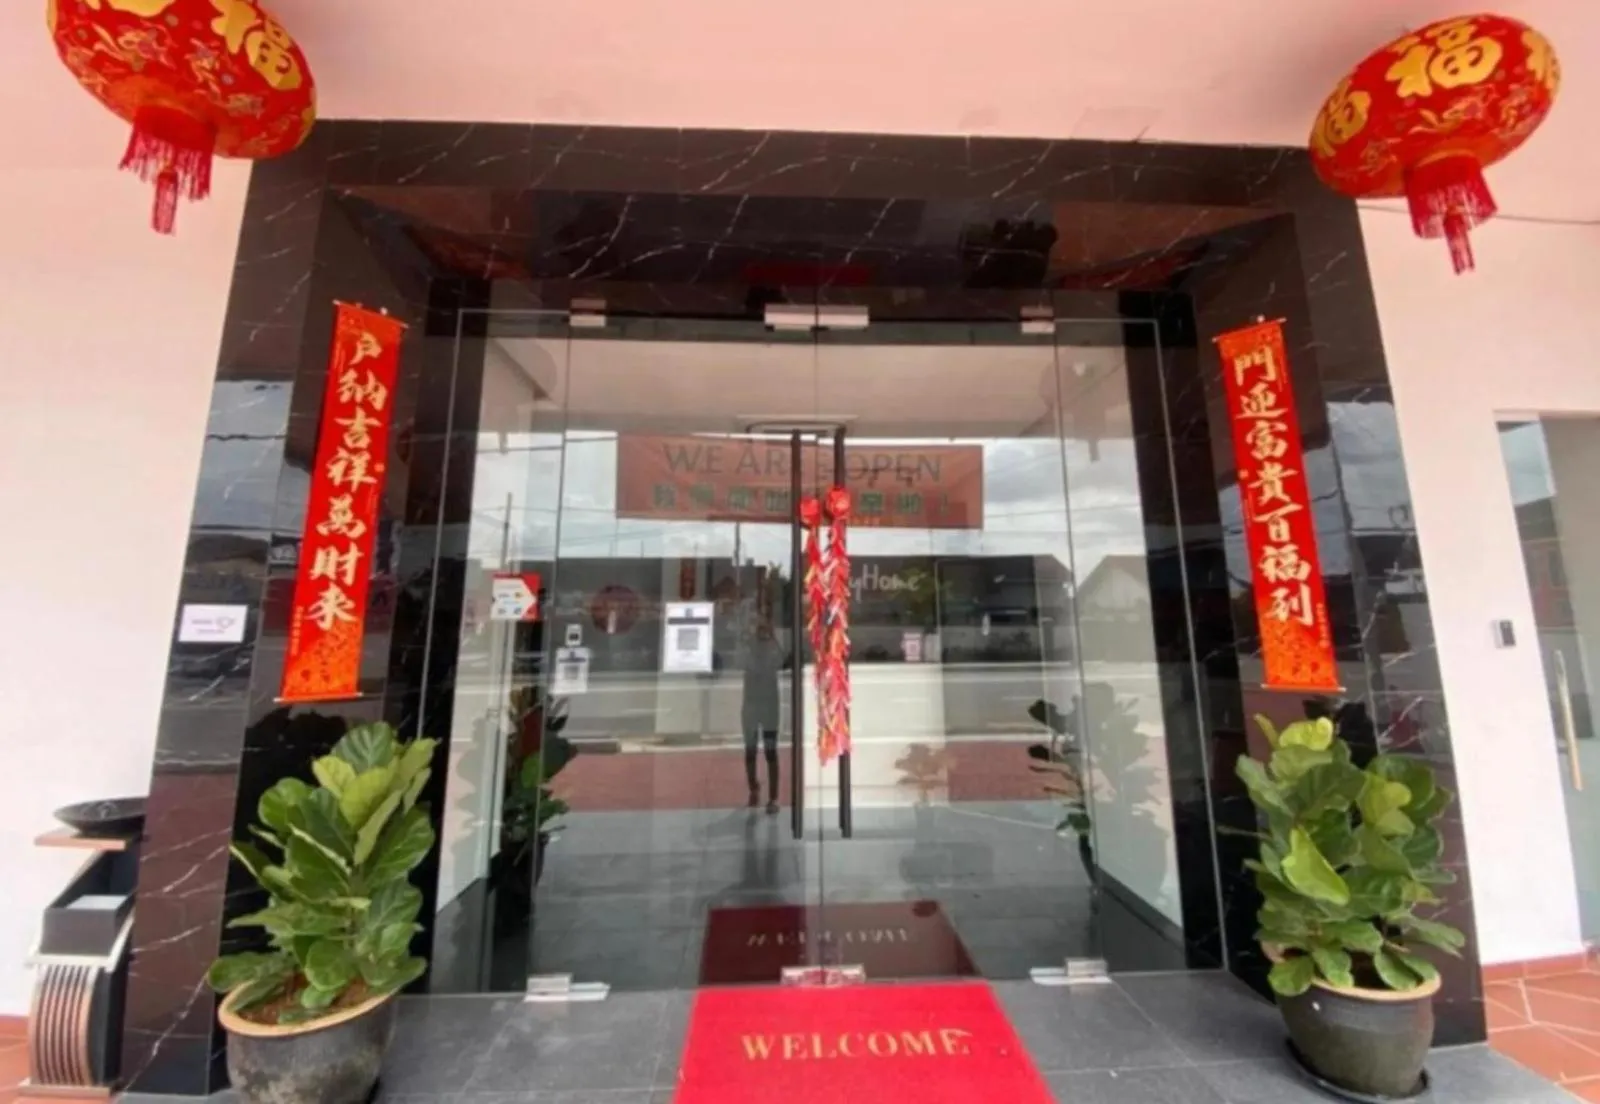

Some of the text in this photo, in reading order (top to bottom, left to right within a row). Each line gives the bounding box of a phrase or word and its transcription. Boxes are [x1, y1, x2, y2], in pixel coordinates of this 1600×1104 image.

[1385, 18, 1503, 98] 福
[662, 443, 723, 474] WE
[843, 453, 941, 484] OPEN
[741, 1027, 973, 1060] WELCOME
